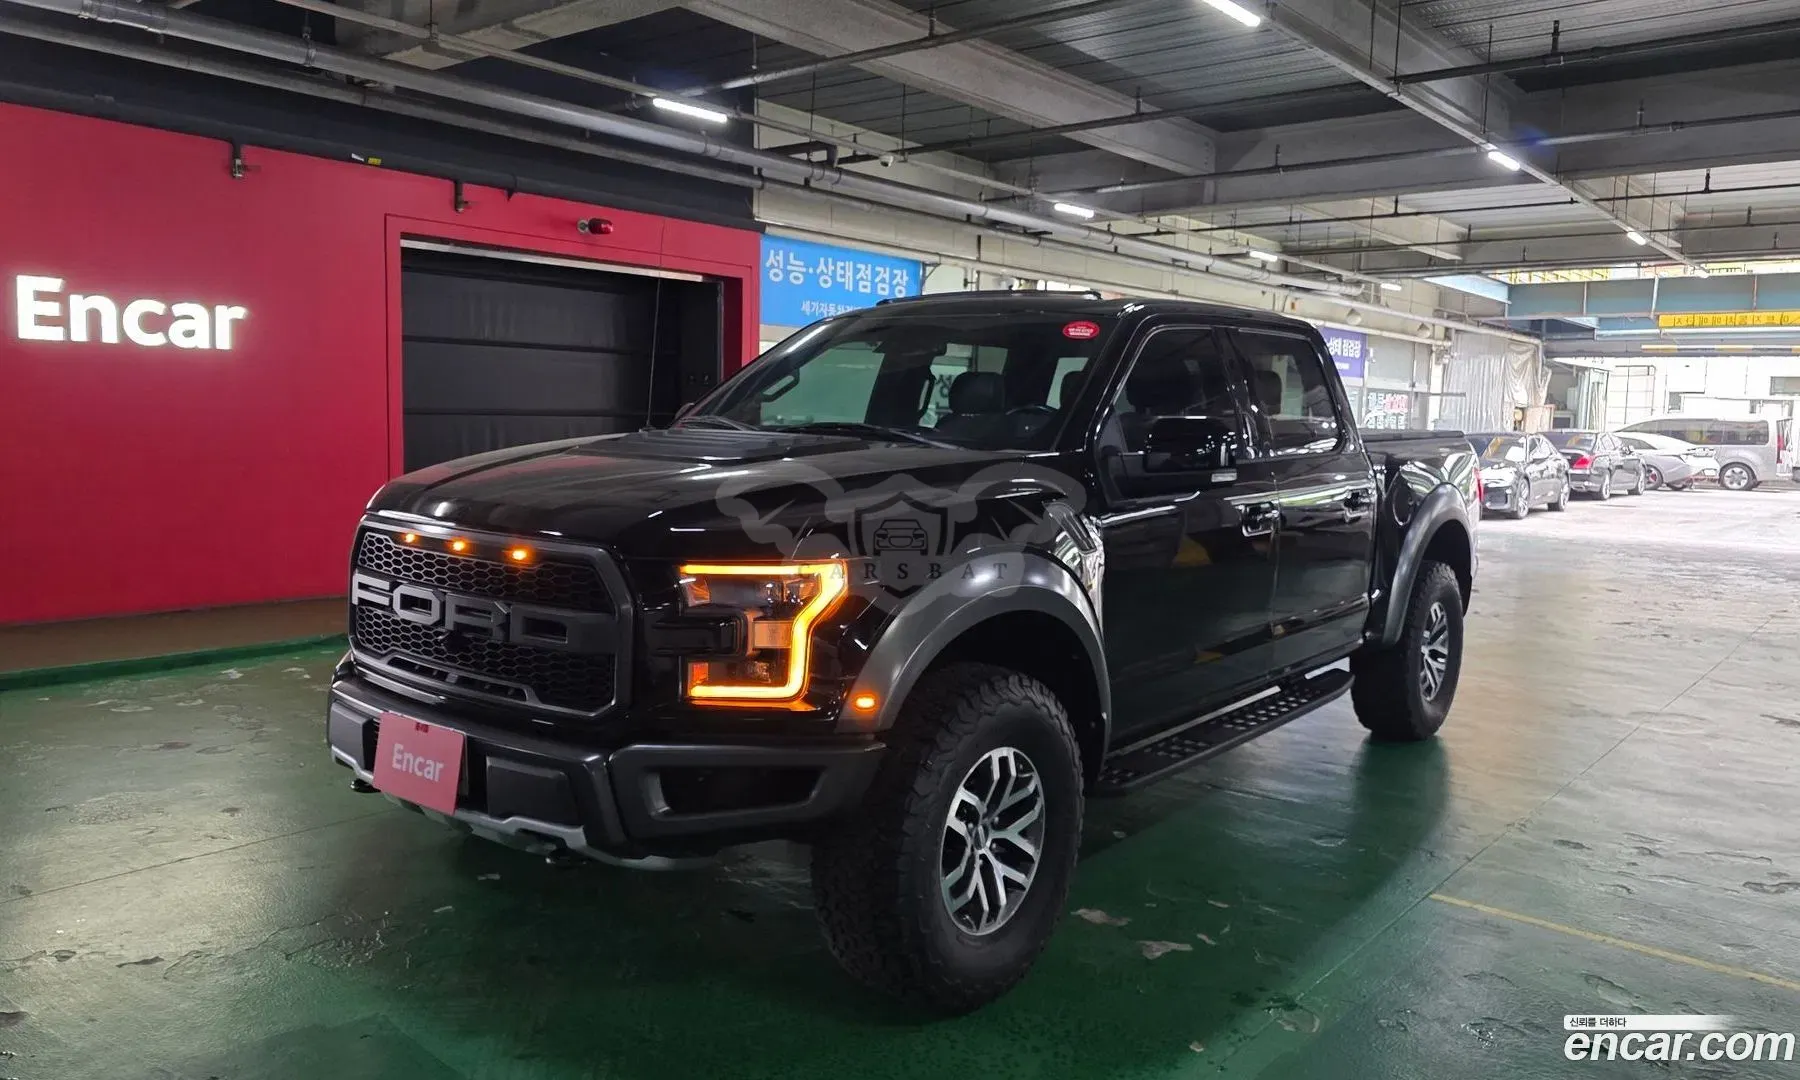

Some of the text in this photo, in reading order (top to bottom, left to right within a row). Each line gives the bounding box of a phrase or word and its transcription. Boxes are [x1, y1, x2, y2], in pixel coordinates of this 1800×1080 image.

[765, 249, 909, 298] 성능·상태점검장
[16, 274, 249, 350] Encar
[352, 571, 580, 646] FORD
[391, 743, 444, 782] Encar
